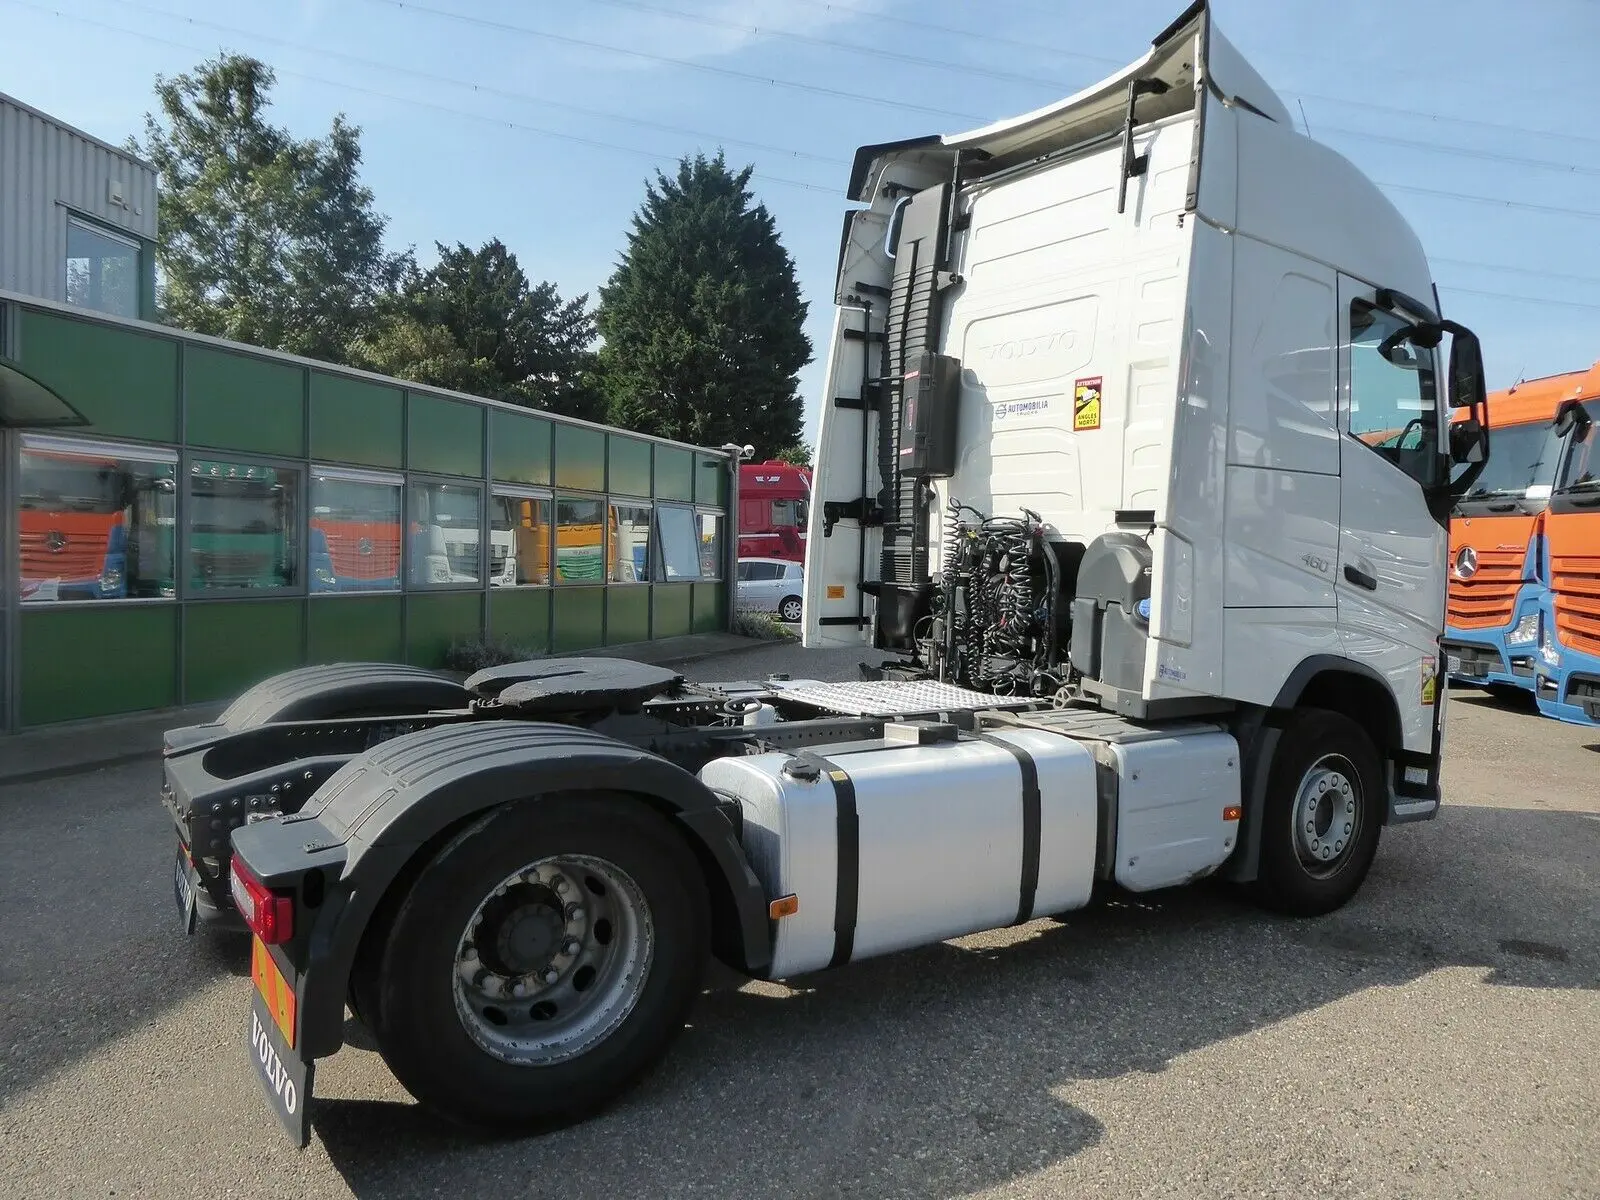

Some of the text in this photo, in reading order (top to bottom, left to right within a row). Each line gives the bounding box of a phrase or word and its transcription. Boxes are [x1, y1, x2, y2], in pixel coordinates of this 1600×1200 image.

[1007, 400, 1049, 413] AUTOMOBILIA
[1078, 412, 1097, 420] ANGLES
[1300, 553, 1329, 573] 460
[252, 1010, 296, 1114] VOLVO
